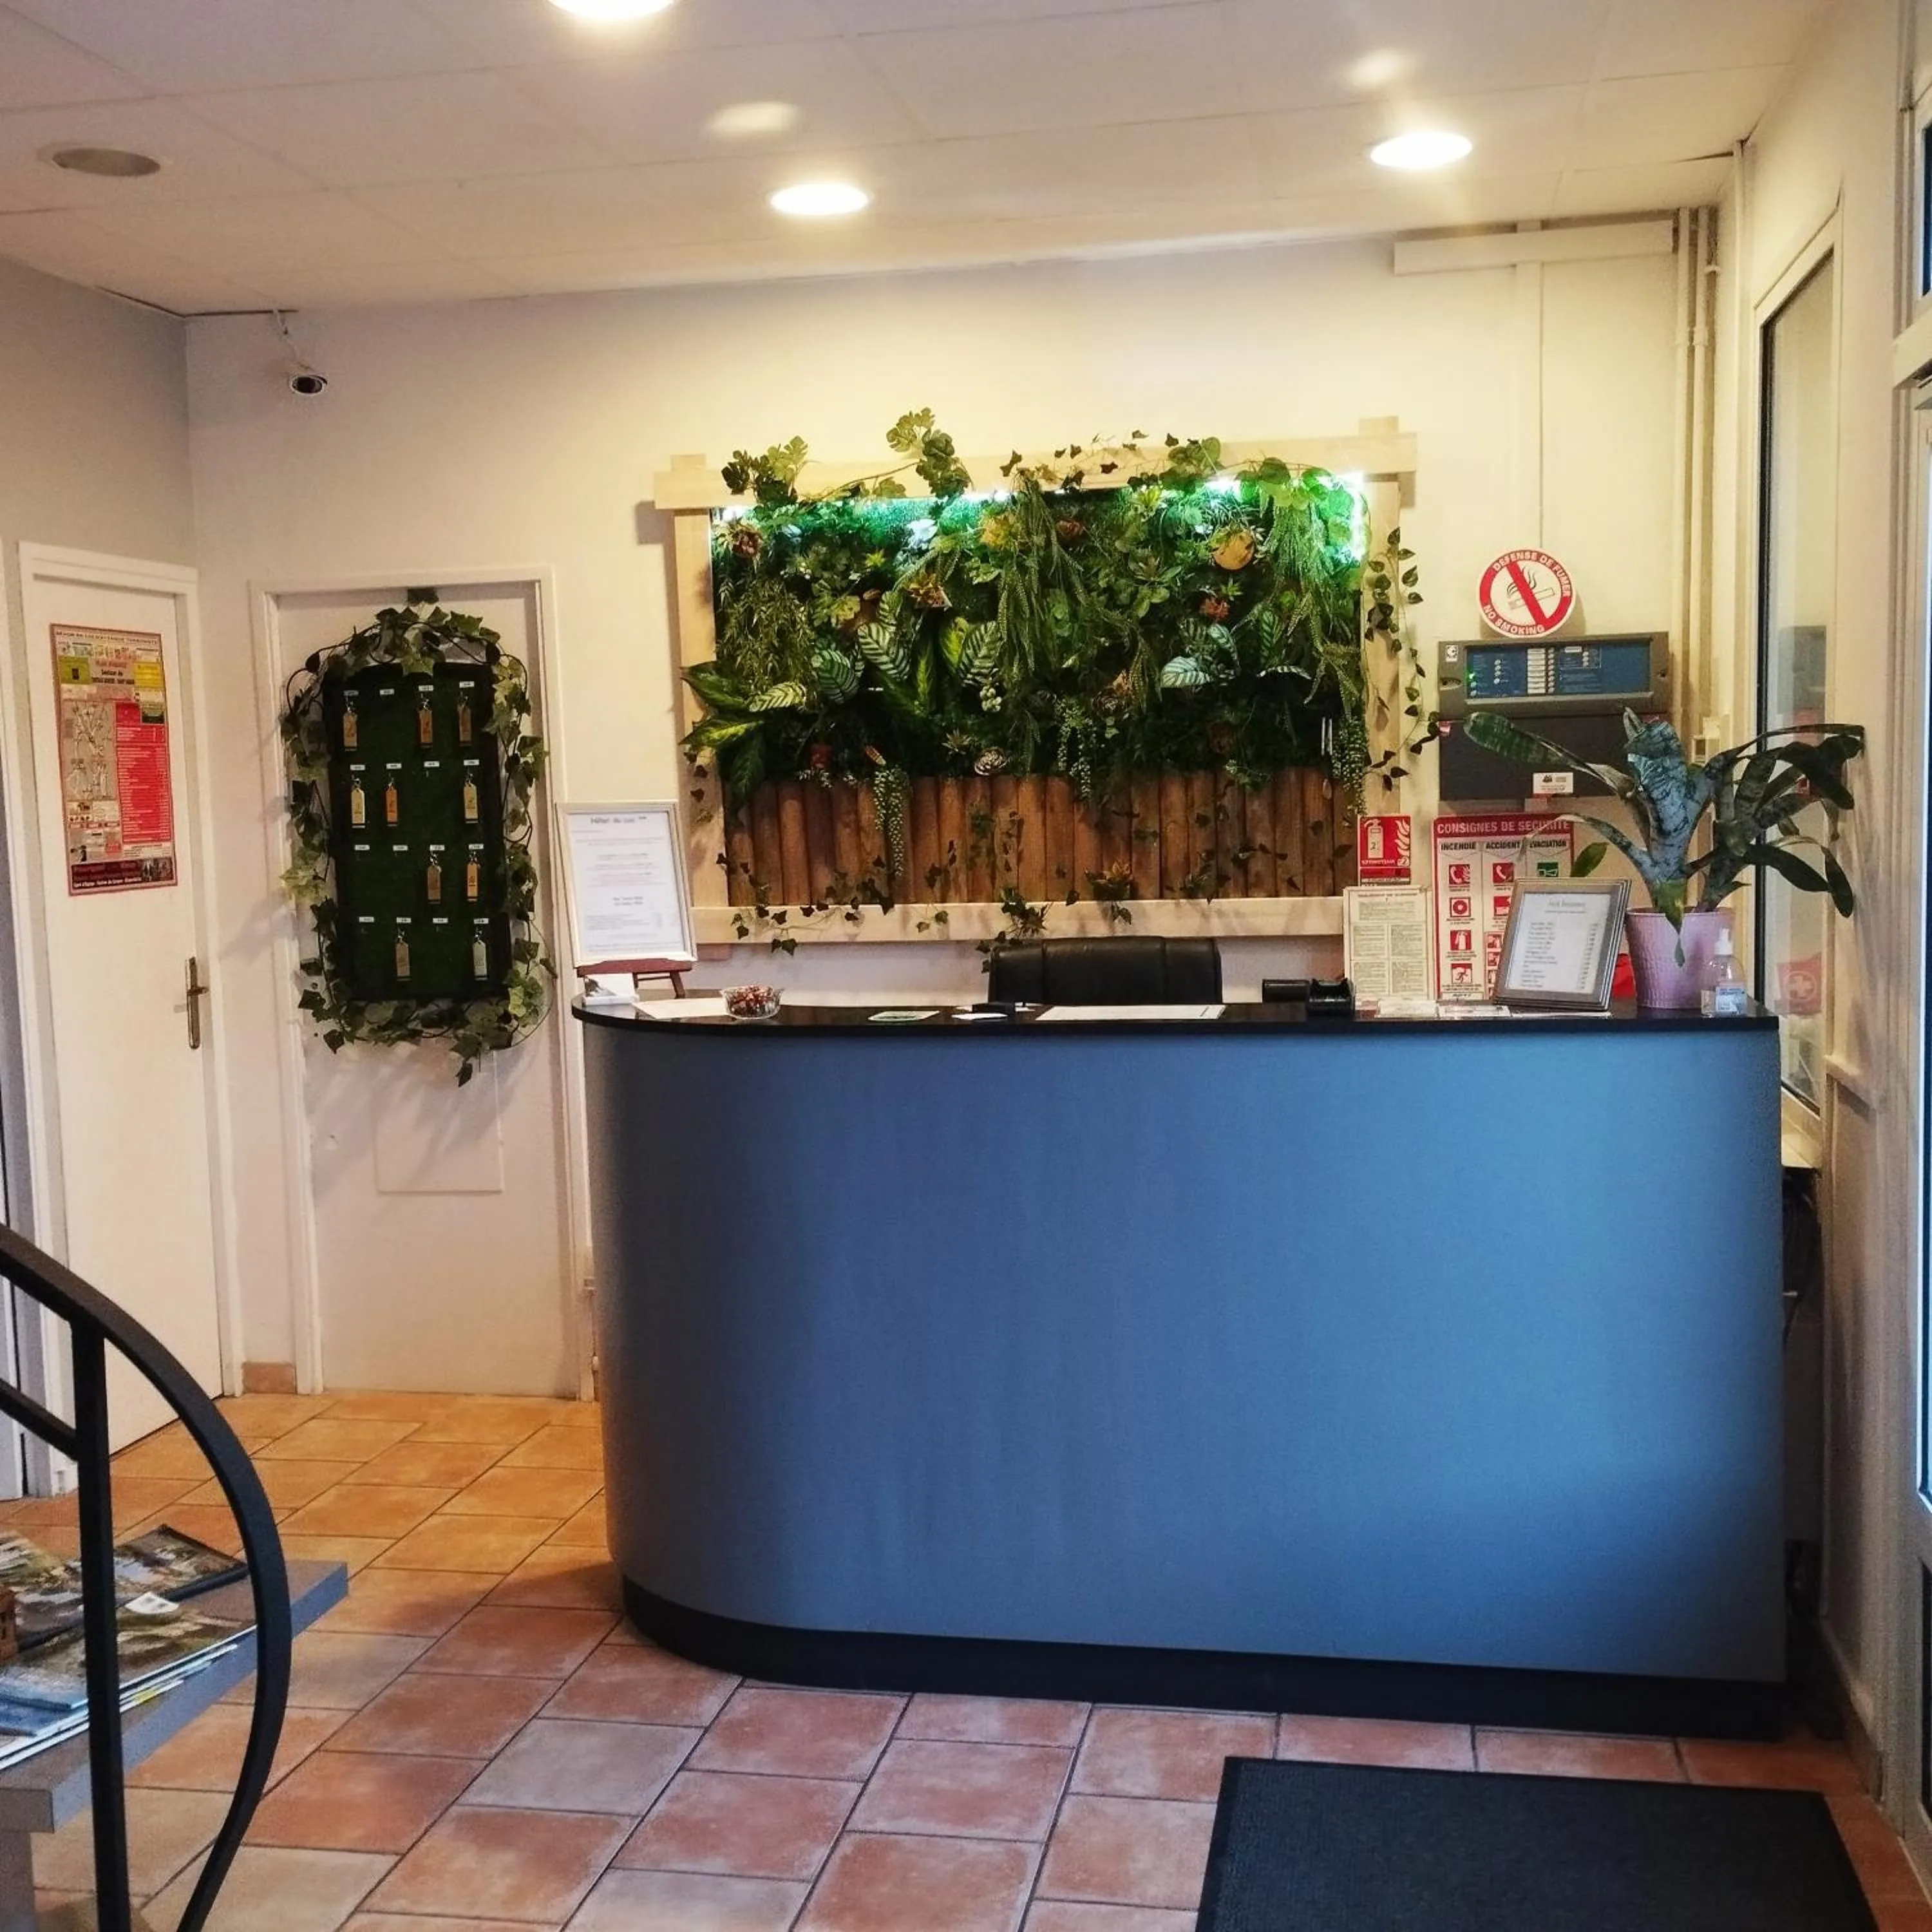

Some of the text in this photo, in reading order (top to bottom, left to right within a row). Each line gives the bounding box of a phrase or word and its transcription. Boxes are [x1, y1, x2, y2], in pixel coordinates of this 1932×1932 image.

[1493, 551, 1571, 597] DEFENSE DE FUMER
[1483, 605, 1545, 634] NO SMOKING
[1437, 822, 1497, 834] CONSIGNES
[1501, 821, 1515, 831] DE
[1441, 842, 1476, 851] INCENDIE
[1486, 840, 1520, 849] ACCIDENT
